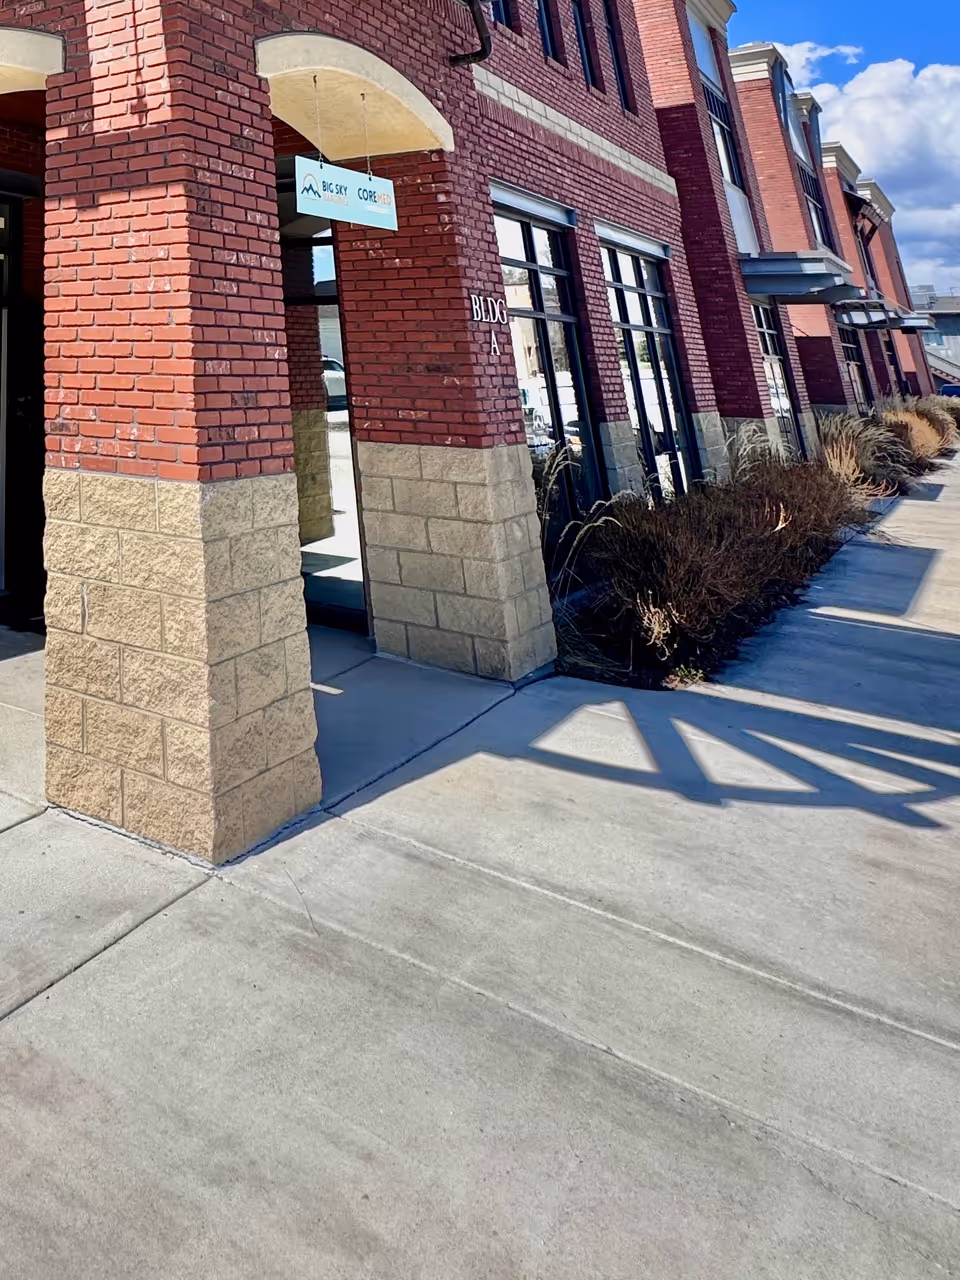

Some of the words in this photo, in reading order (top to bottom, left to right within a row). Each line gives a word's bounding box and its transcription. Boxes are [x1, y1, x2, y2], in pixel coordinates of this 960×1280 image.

[322, 180, 334, 194] BIG
[335, 183, 348, 197] SKY
[357, 187, 392, 206] COREMED
[470, 294, 508, 324] BLDG
[490, 329, 501, 356] A
